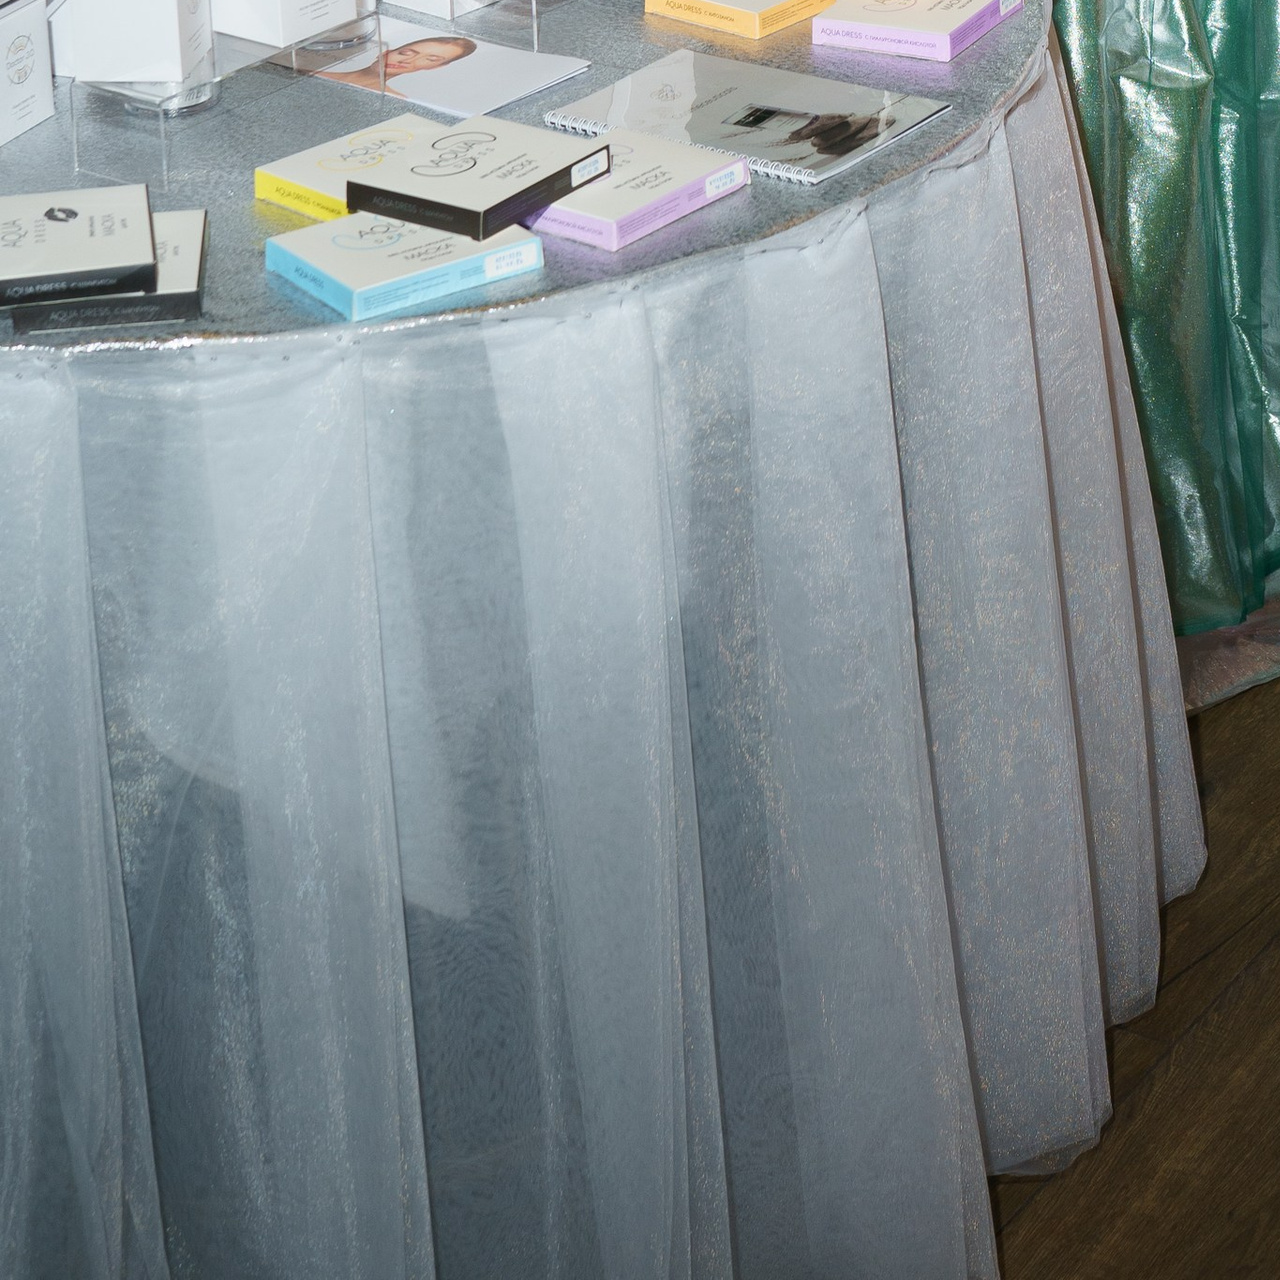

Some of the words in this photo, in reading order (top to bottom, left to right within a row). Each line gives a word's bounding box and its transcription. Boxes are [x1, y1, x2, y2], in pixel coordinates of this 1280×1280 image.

[665, 0, 684, 10] AQUA
[683, 2, 702, 15] DRESS
[820, 27, 841, 37] AQUA
[841, 30, 863, 40] DRESS
[340, 140, 398, 161] AQUA
[430, 141, 480, 167] AQUA
